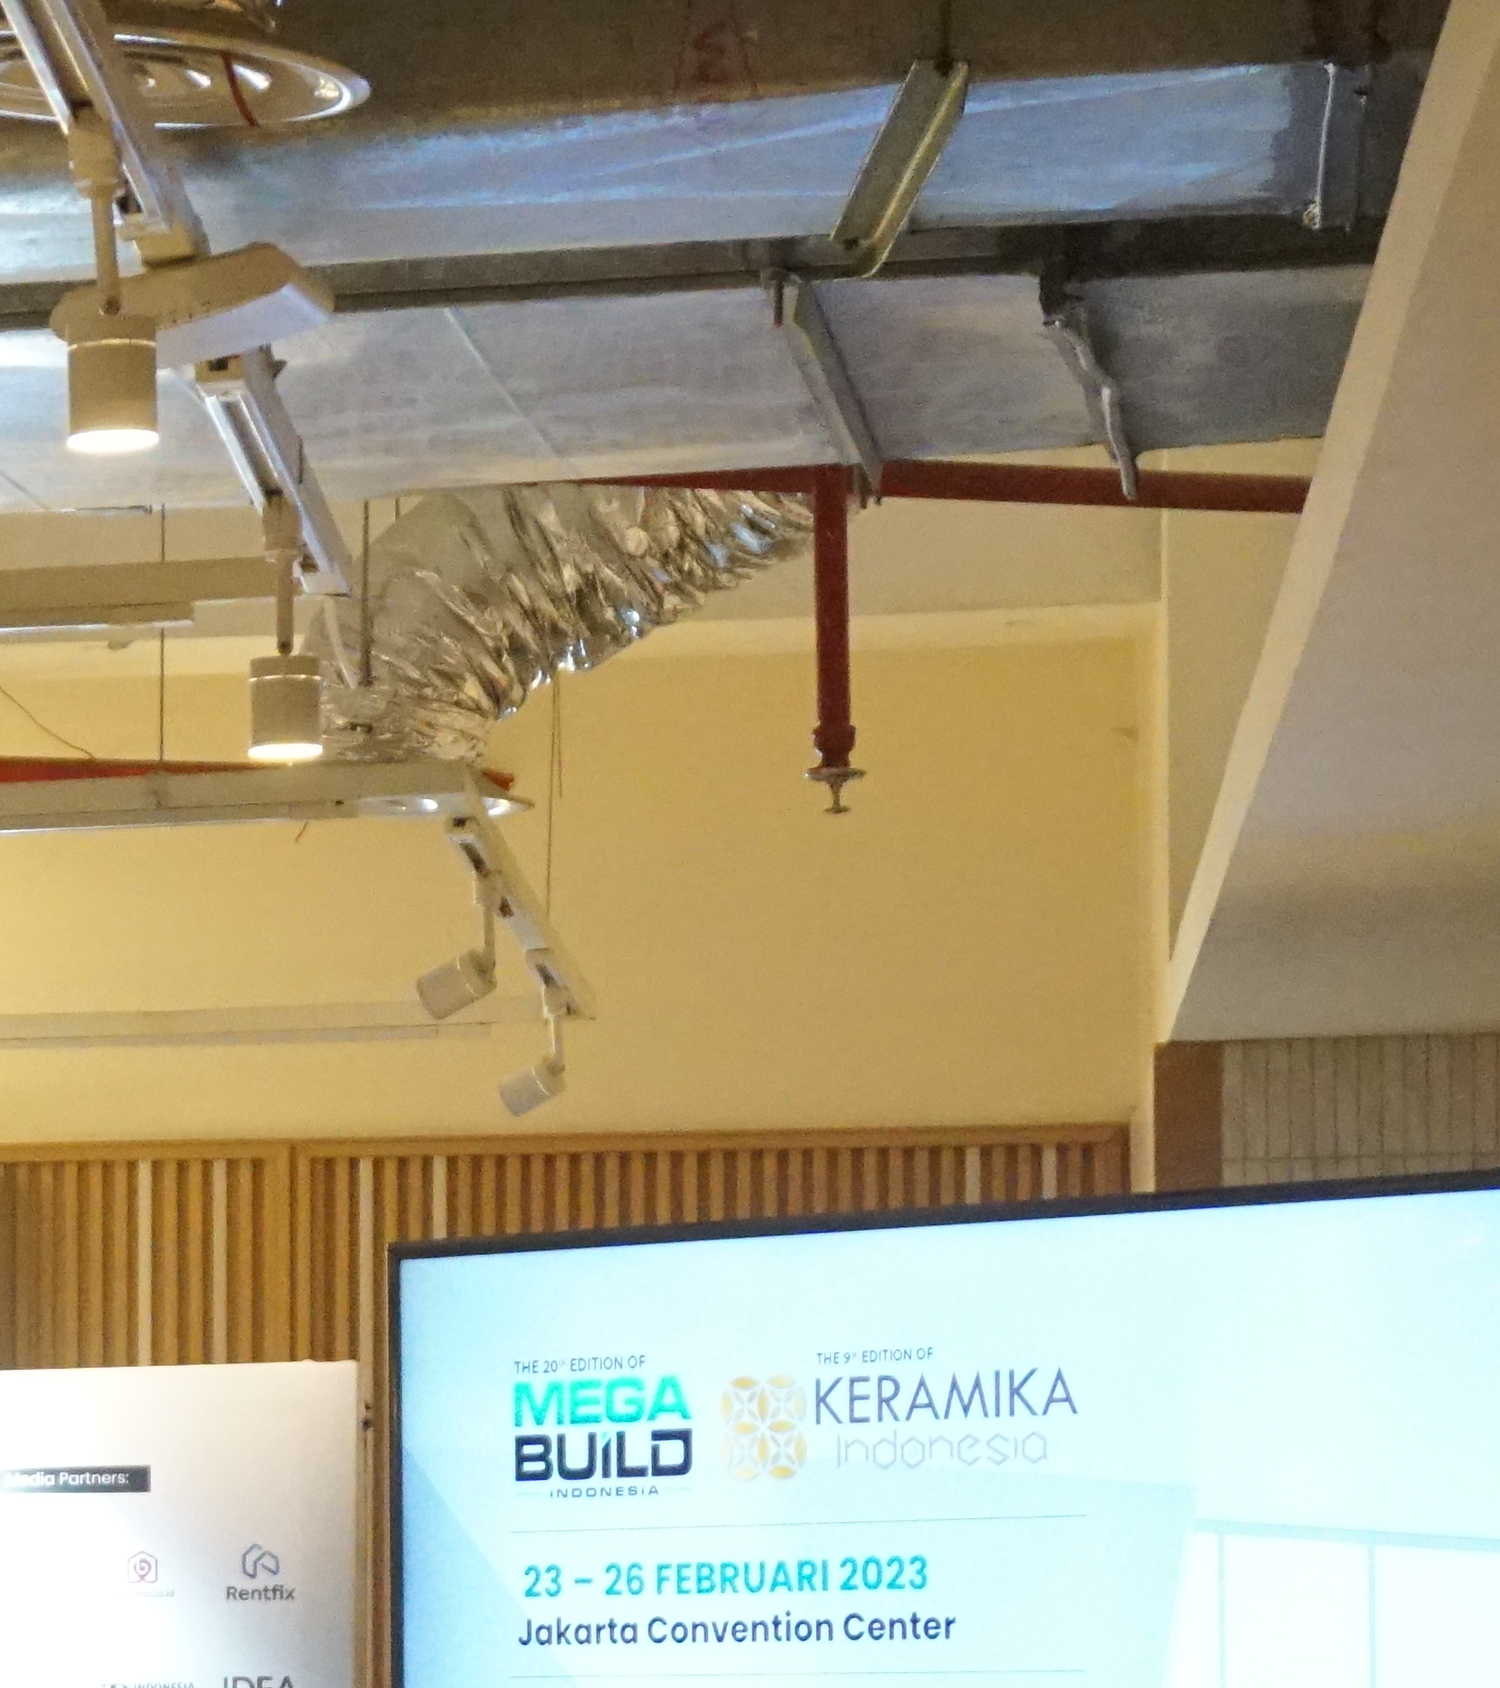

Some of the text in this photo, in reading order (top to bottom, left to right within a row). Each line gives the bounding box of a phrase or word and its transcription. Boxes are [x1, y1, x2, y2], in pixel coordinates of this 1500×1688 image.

[514, 1360, 540, 1375] THE
[569, 1357, 624, 1373] EDITION
[627, 1354, 646, 1370] OF
[816, 1352, 838, 1366] THE
[860, 1349, 910, 1363] EDITION
[913, 1347, 934, 1361] OF
[514, 1374, 693, 1428] MEGA
[814, 1367, 1079, 1426] KERAMIKA
[514, 1427, 694, 1481] BUILD
[836, 1429, 1049, 1470] Indonesia
[59, 1470, 130, 1486] Partners:
[549, 1486, 660, 1499] INDONESIA
[225, 1584, 296, 1602] Rentfix
[523, 1564, 563, 1598] 23
[604, 1561, 645, 1597] 26
[655, 1558, 830, 1595] FEBRUARI
[839, 1554, 928, 1592] 2023
[518, 1609, 957, 1647] Jakarta Convention Center
